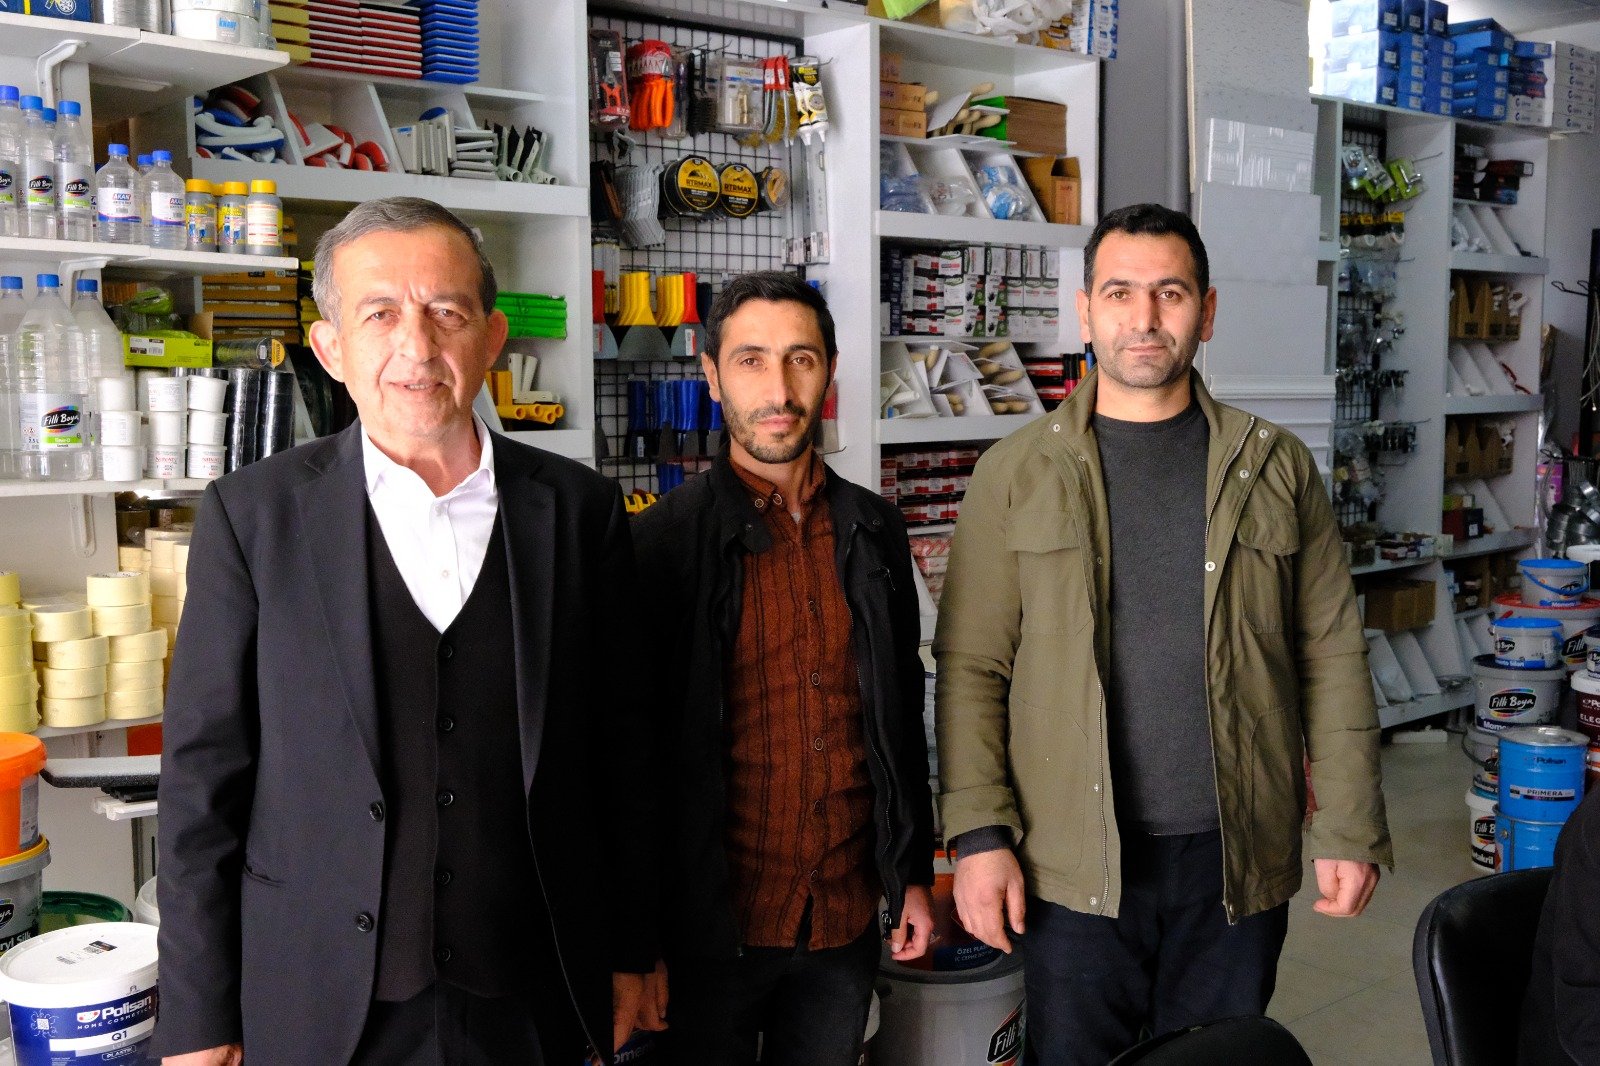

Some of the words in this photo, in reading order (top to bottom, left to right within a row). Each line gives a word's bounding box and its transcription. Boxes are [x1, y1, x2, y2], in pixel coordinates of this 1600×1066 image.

[724, 182, 752, 194] RTRMAX
[44, 413, 59, 425] Filli
[60, 413, 80, 425] Boya
[1491, 696, 1507, 709] Filli
[1509, 695, 1534, 710] Boya
[102, 996, 152, 1020] Polisan
[77, 1022, 103, 1030] HOME
[111, 1030, 128, 1041] Q1
[993, 1022, 1017, 1056] Filli
